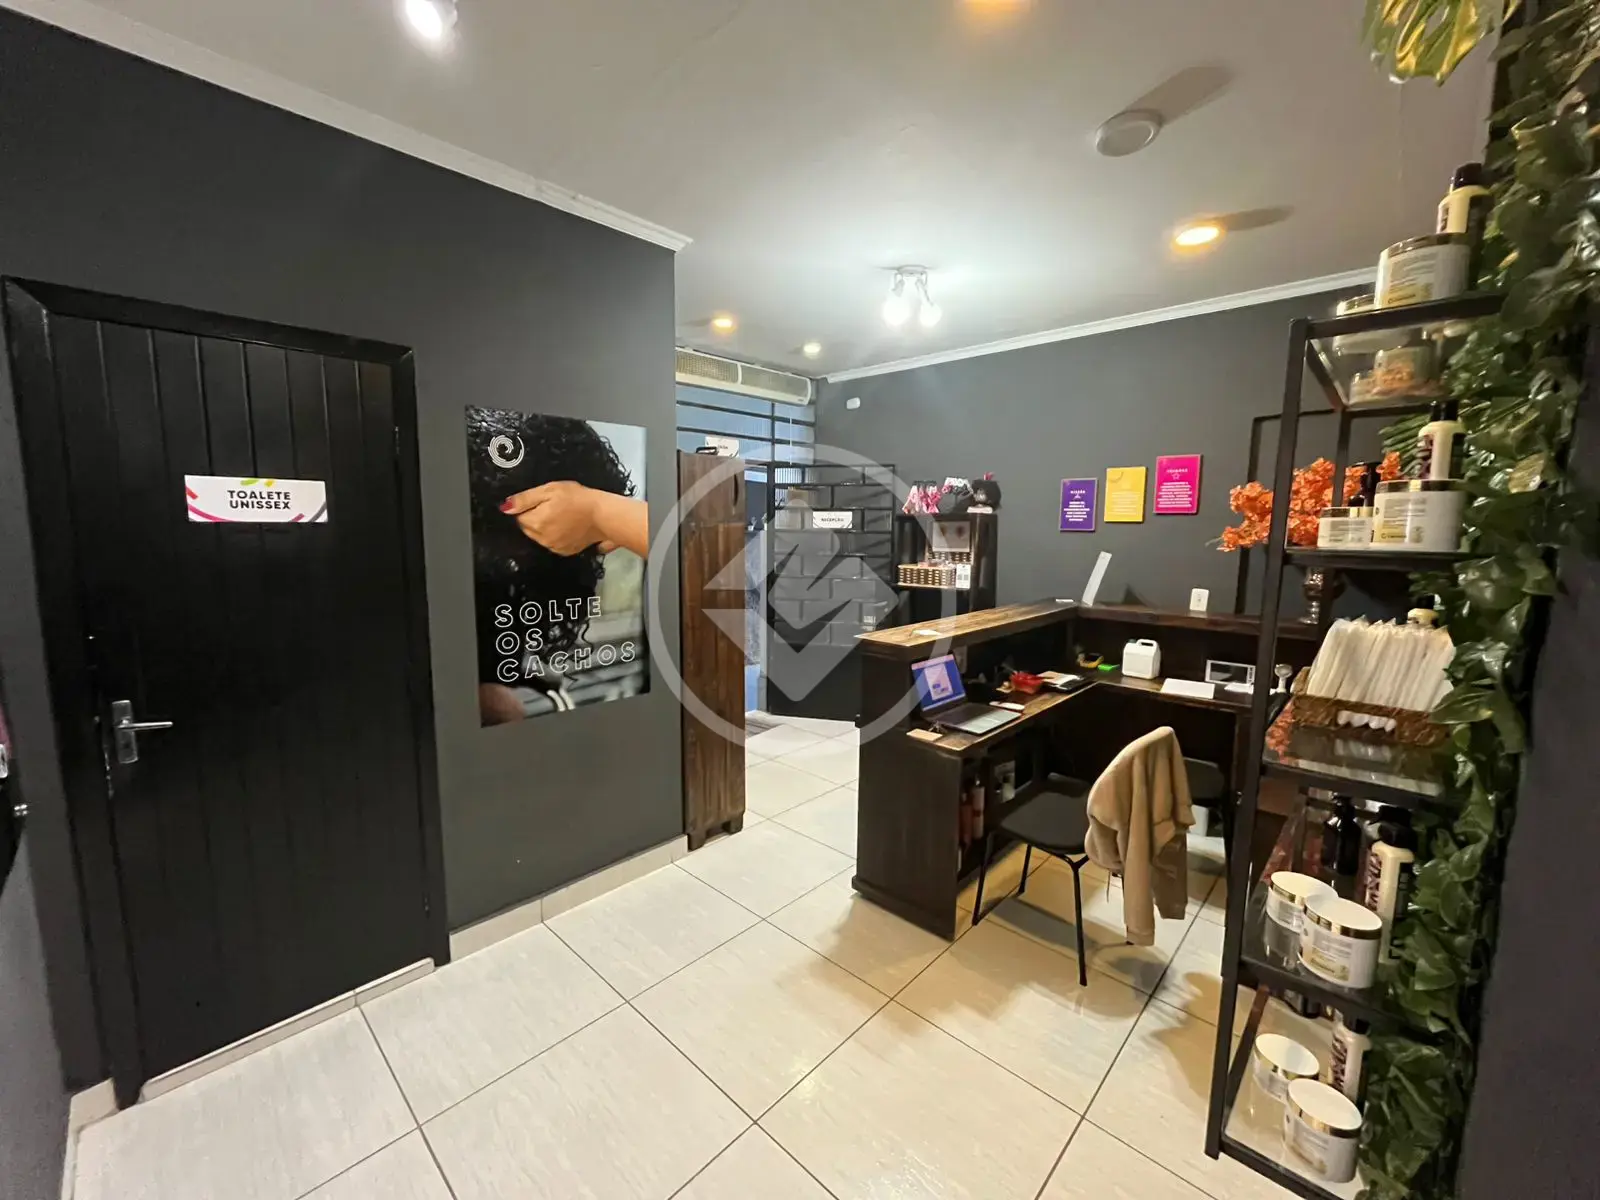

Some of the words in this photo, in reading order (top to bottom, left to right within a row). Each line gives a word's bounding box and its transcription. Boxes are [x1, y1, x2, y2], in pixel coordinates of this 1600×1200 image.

[227, 490, 291, 500] TOALETE
[229, 500, 291, 509] UNISSEX
[494, 597, 601, 628] SOLTE
[496, 628, 544, 655] OS
[497, 642, 635, 682] CACHOS
